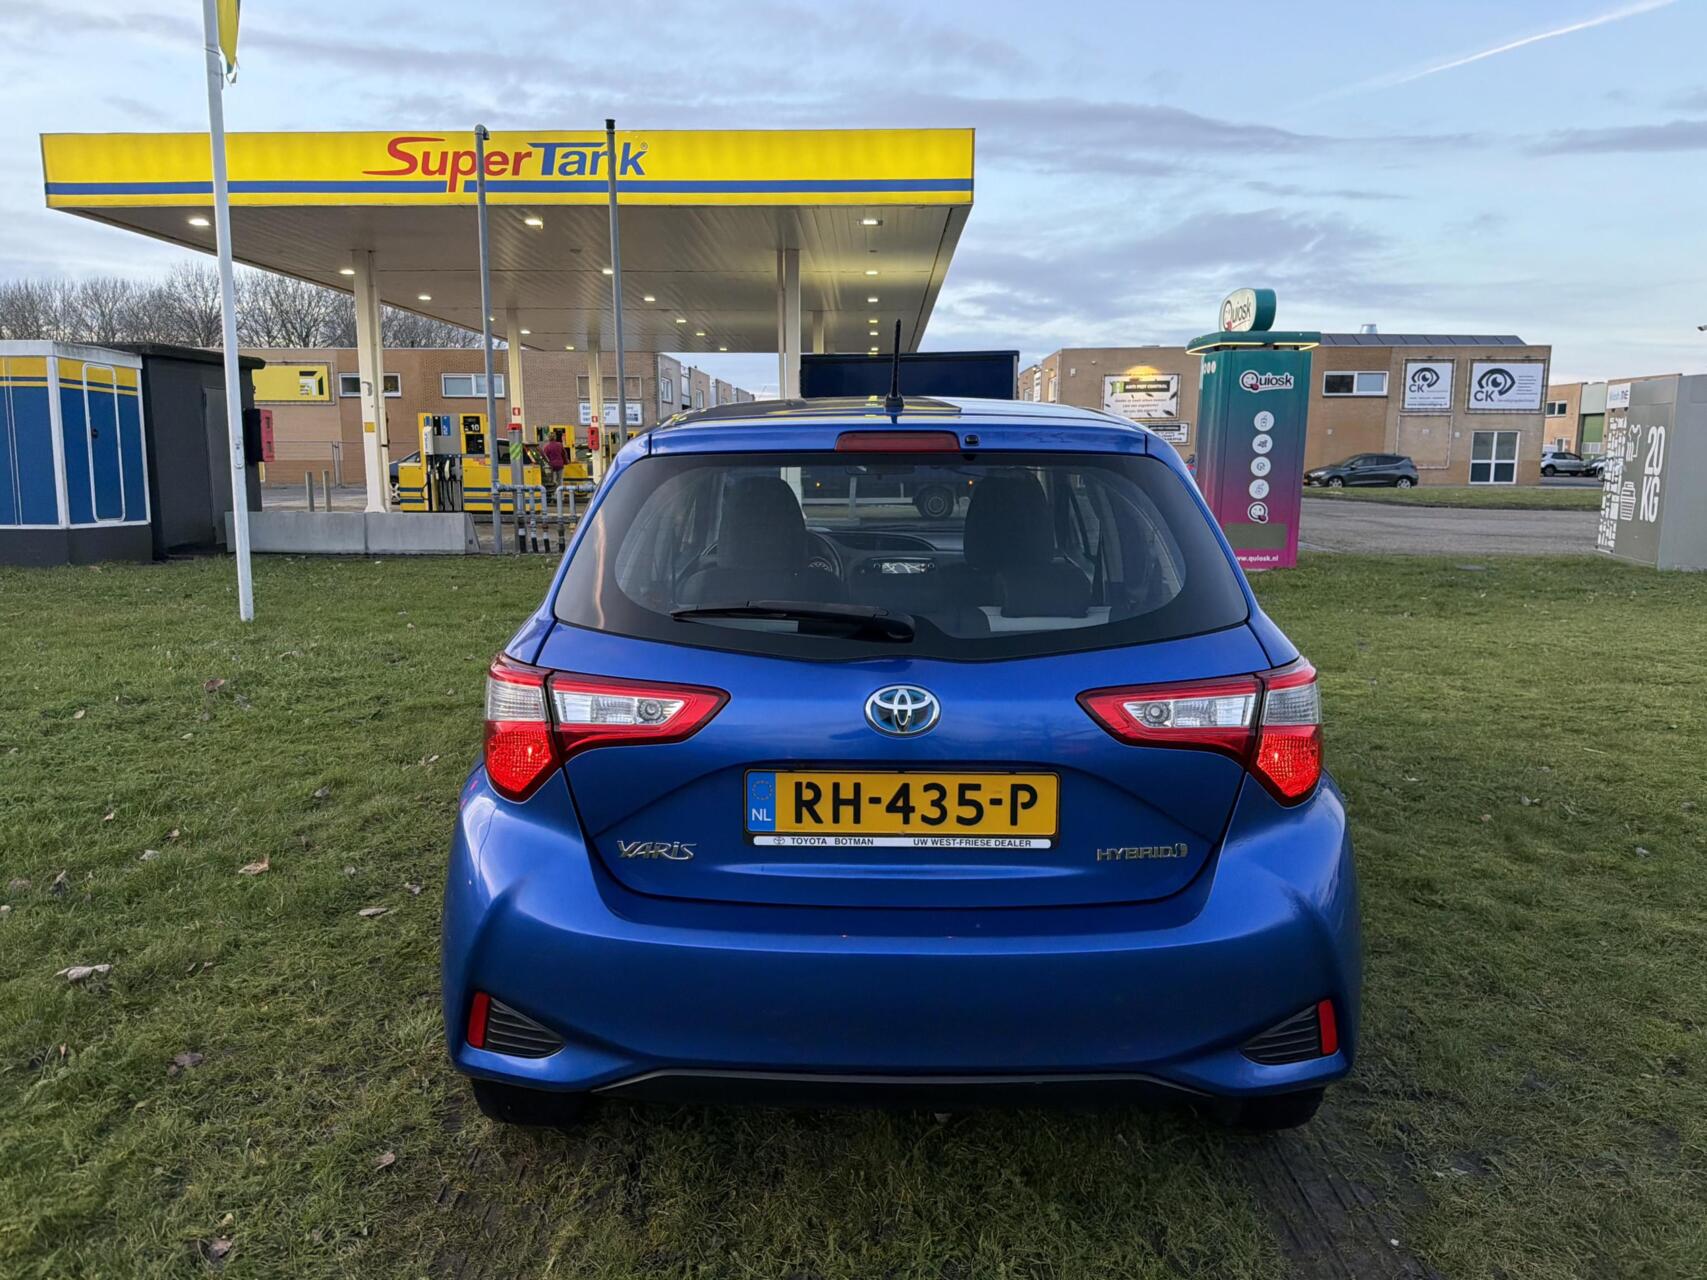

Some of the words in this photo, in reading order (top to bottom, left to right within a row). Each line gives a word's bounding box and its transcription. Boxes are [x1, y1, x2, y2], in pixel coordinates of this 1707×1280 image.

[361, 136, 648, 193] SuperTank
[1222, 296, 1252, 332] Quiosk
[1241, 372, 1293, 391] Quiosk
[1409, 383, 1425, 393] CK
[1473, 390, 1495, 402] CK
[1645, 426, 1665, 476] 20
[1640, 476, 1660, 523] KG
[1236, 555, 1279, 563] ww.quiosk.nl
[794, 781, 1038, 826] RH-435-P
[751, 808, 772, 822] NL
[791, 837, 828, 845] TOYOTA
[834, 837, 874, 846] BOTMAN
[913, 838, 928, 846] UW
[931, 838, 991, 847] WEST-FRIESE
[994, 839, 1032, 847] DEALER
[1096, 846, 1173, 861] HYBRID
